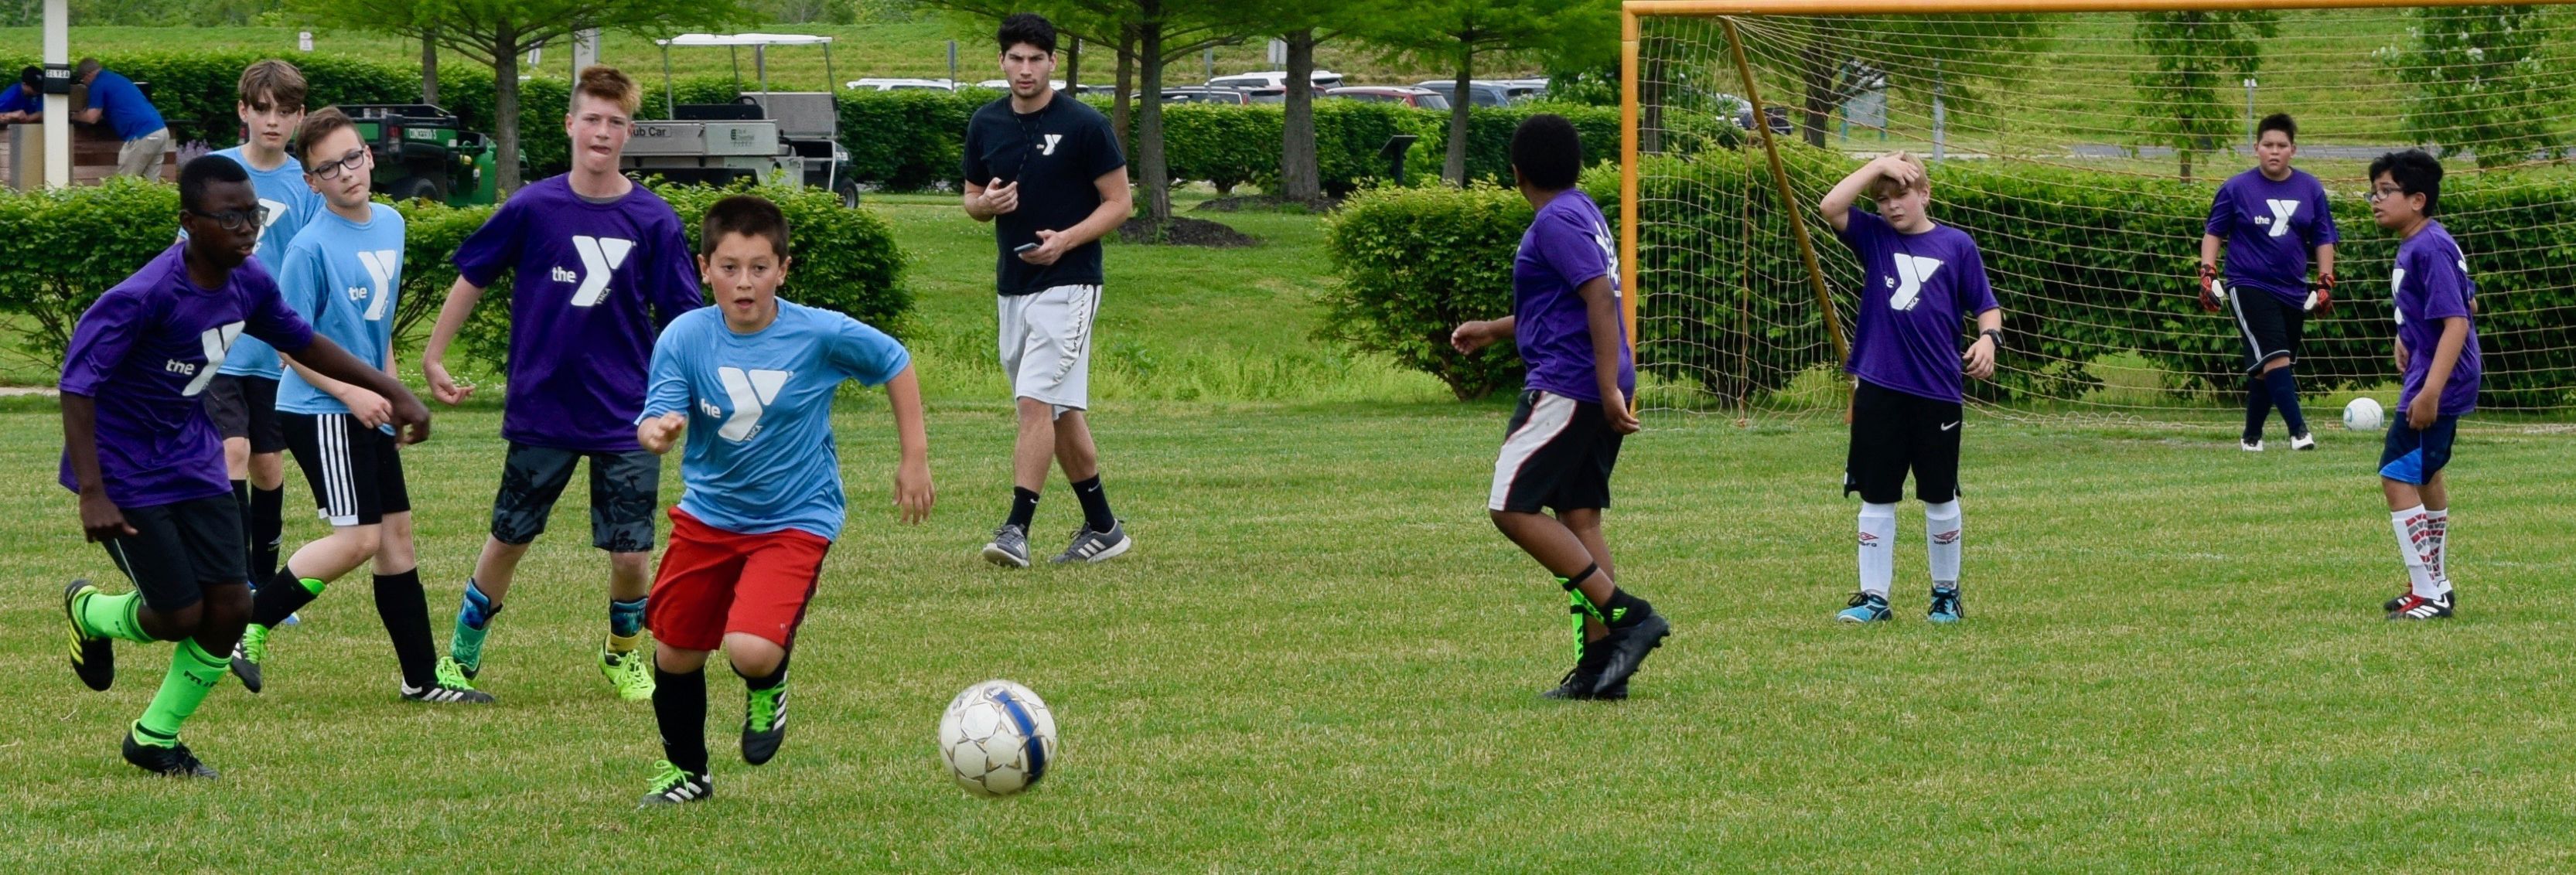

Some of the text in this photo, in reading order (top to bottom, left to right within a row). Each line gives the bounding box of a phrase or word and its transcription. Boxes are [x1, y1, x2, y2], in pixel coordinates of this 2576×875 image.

[631, 126, 666, 136] ub Car
[2254, 215, 2271, 225] the
[551, 235, 633, 307] the Y
[595, 287, 612, 305] YMCA
[165, 358, 195, 376] the
[700, 366, 788, 444] he Y
[745, 424, 763, 442] YMCA
